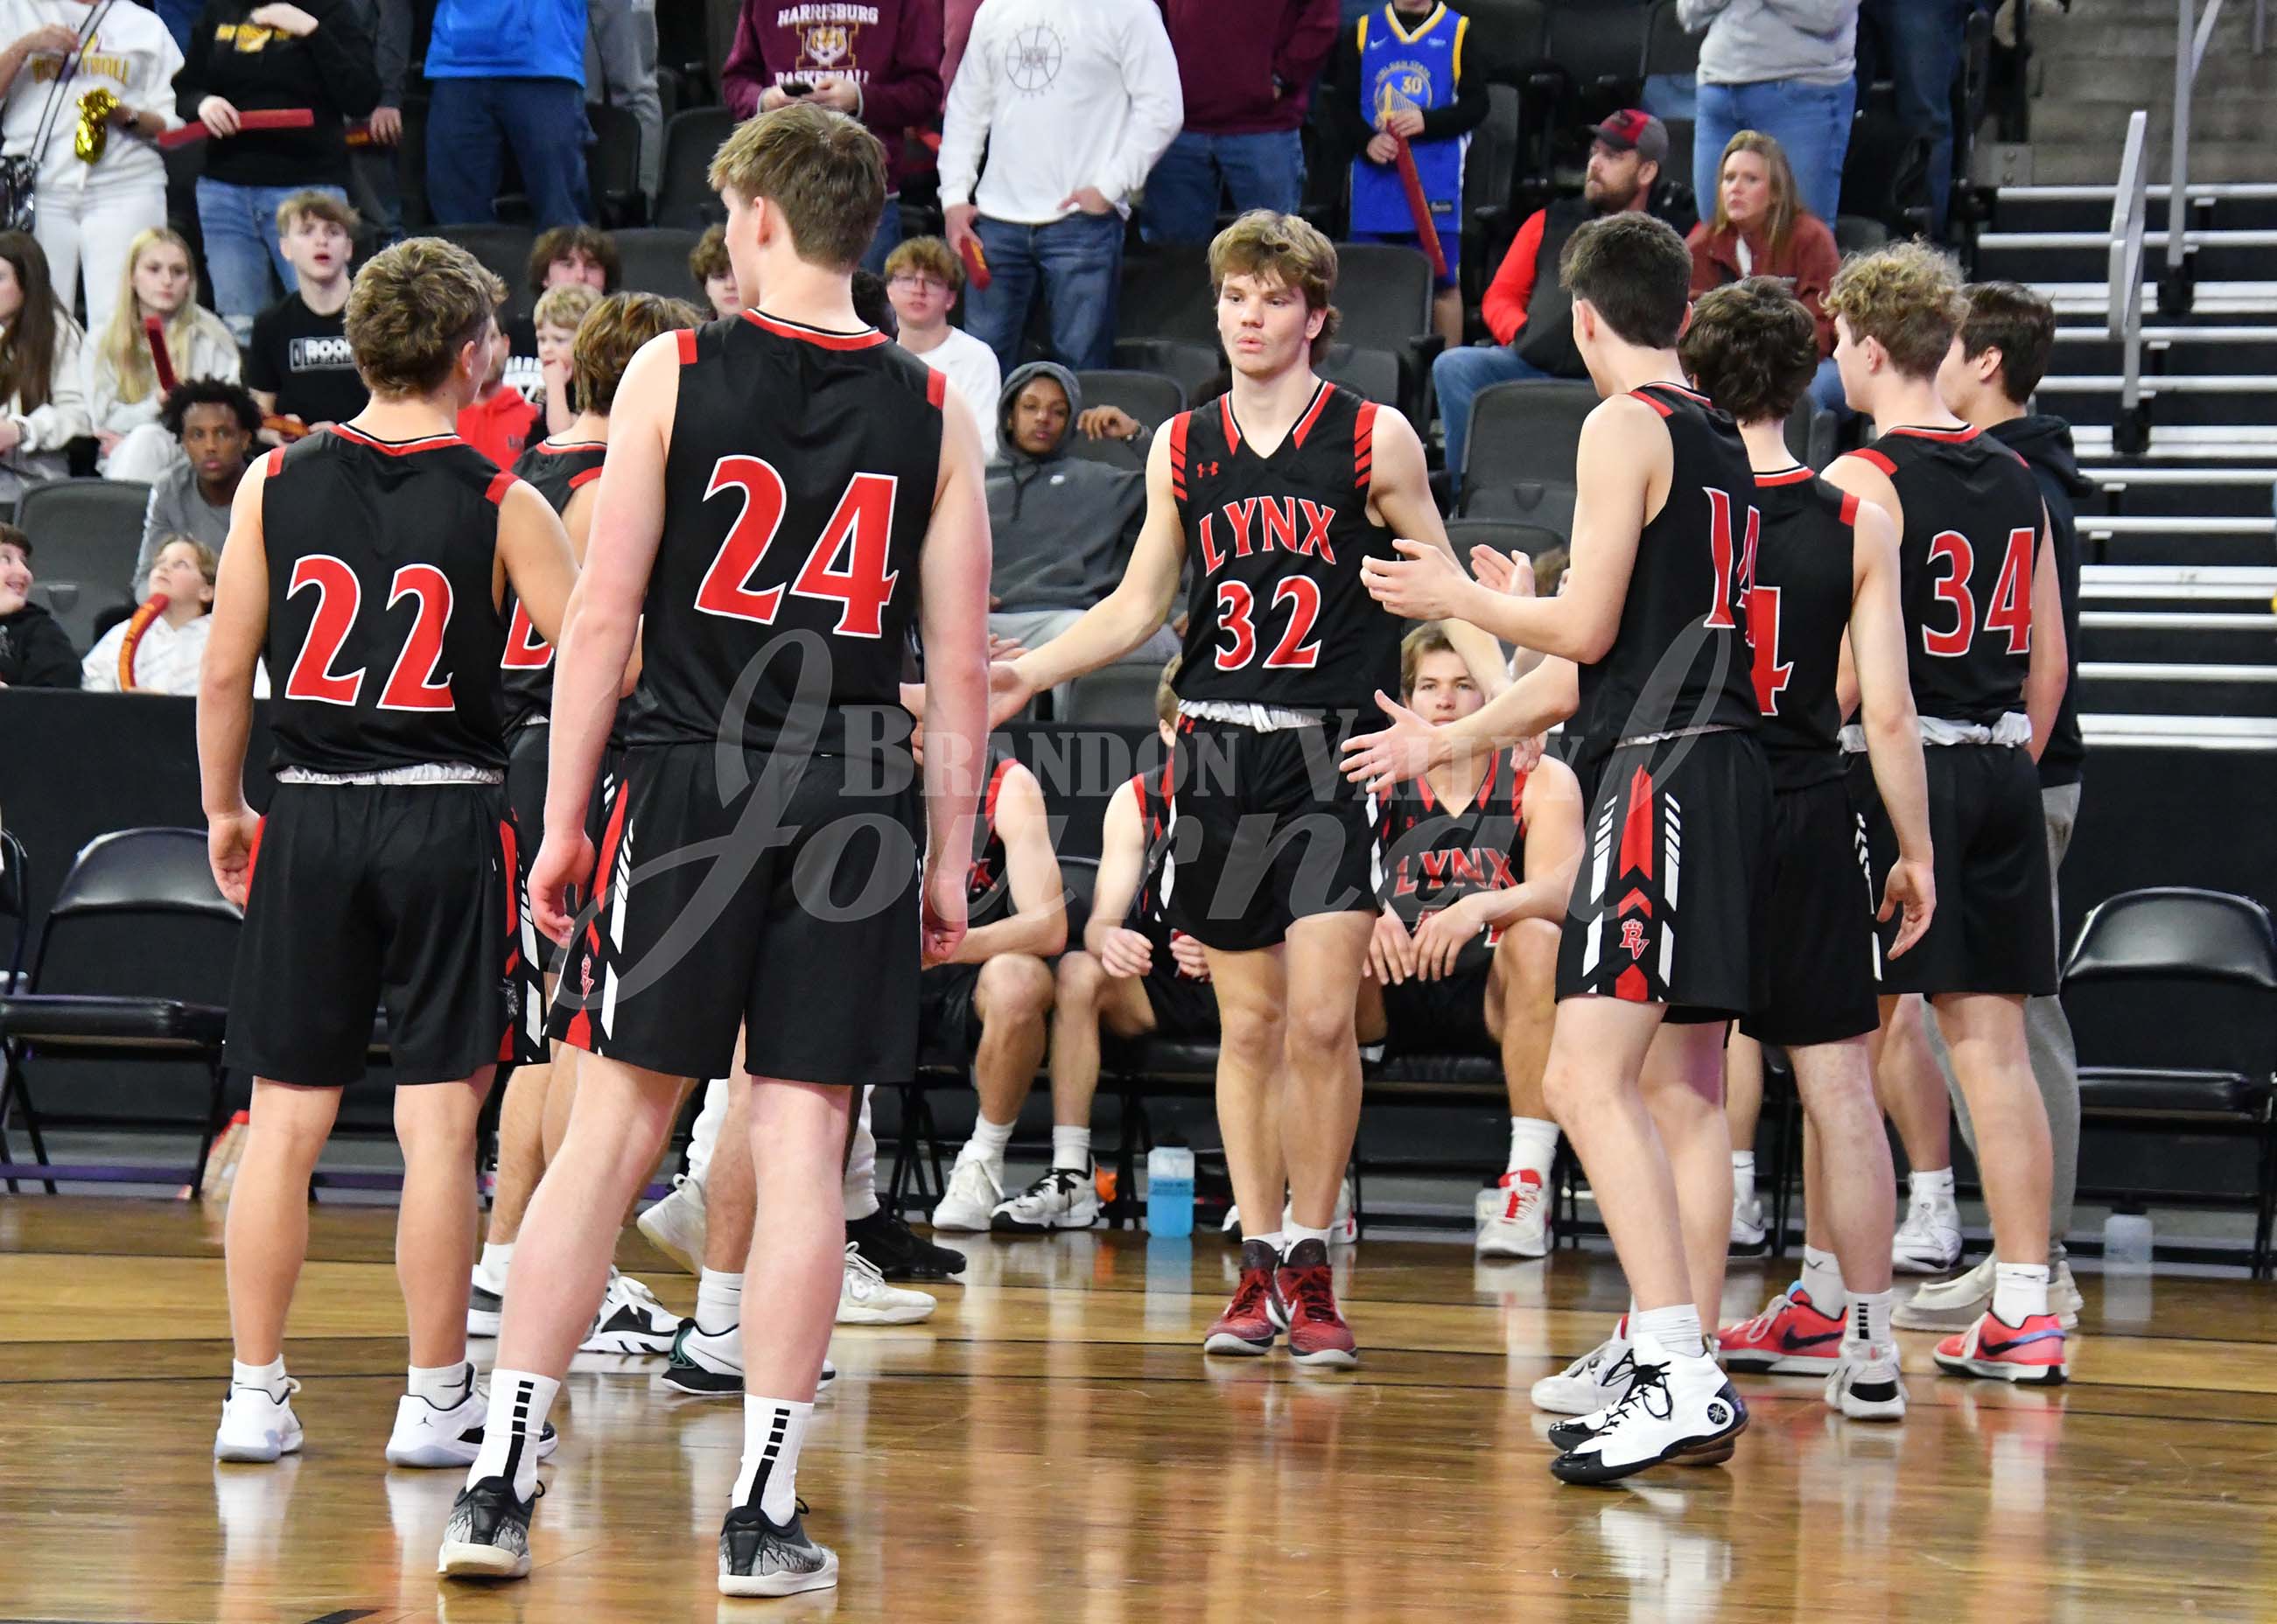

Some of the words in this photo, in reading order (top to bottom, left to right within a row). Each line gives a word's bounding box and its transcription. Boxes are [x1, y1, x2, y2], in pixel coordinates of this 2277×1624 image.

[777, 4, 879, 28] HARRISBURG
[1401, 75, 1423, 95] 30
[694, 454, 900, 639] 24
[1199, 495, 1336, 578] LYNX
[285, 554, 455, 711] 22
[1215, 575, 1322, 671] 32
[1922, 527, 2035, 657] 34
[1393, 847, 1519, 897] LYNX
